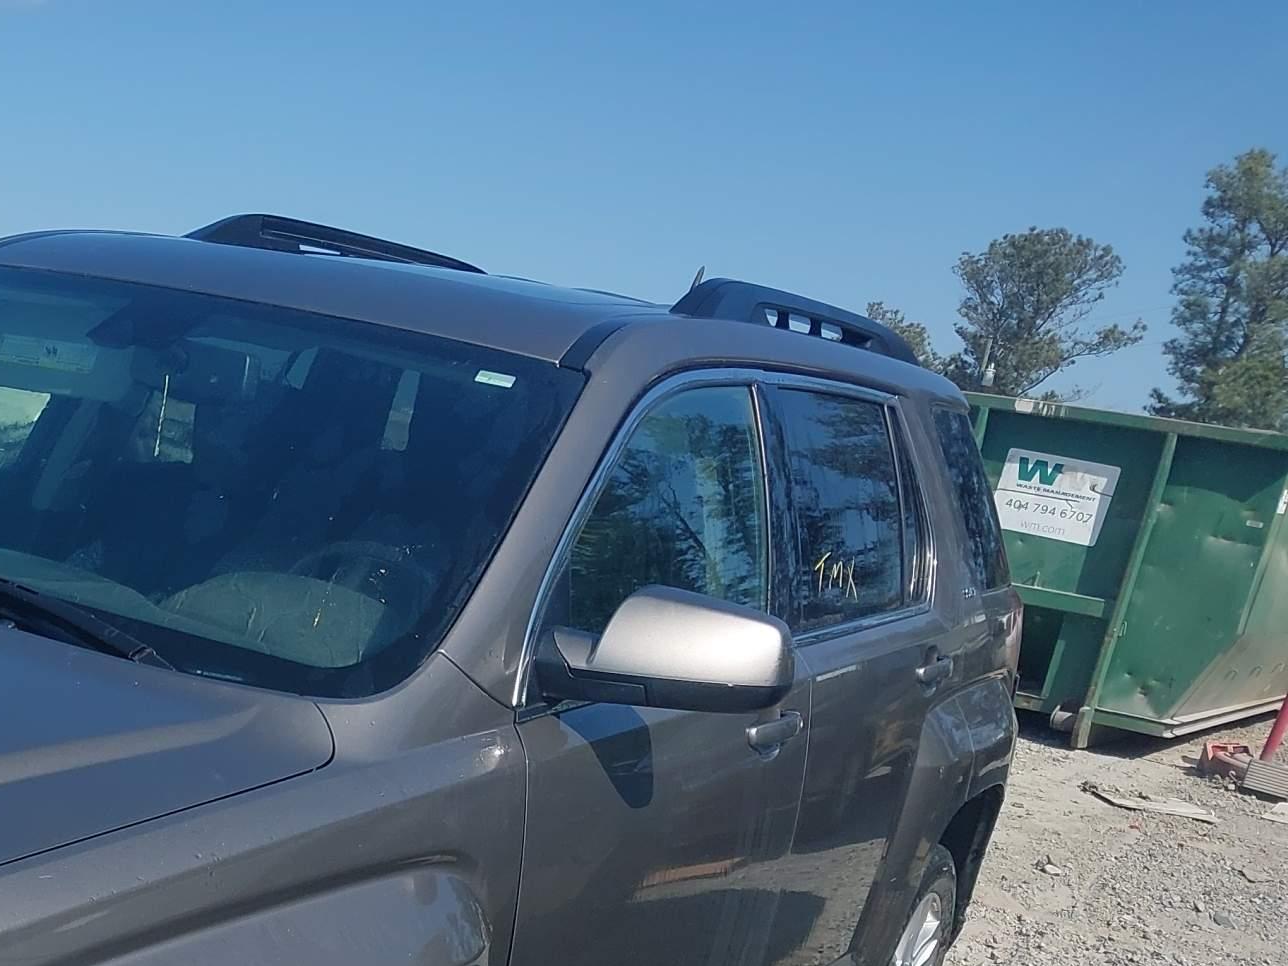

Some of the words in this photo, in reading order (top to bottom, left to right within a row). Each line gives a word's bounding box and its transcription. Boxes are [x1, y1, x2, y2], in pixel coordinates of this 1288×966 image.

[1016, 482, 1041, 493] WASTE
[1042, 488, 1097, 503] MANAGEMENT
[1005, 498, 1029, 512] 404
[1032, 503, 1057, 517] 794
[1059, 508, 1094, 524] 6707
[1020, 519, 1066, 536] wm.com
